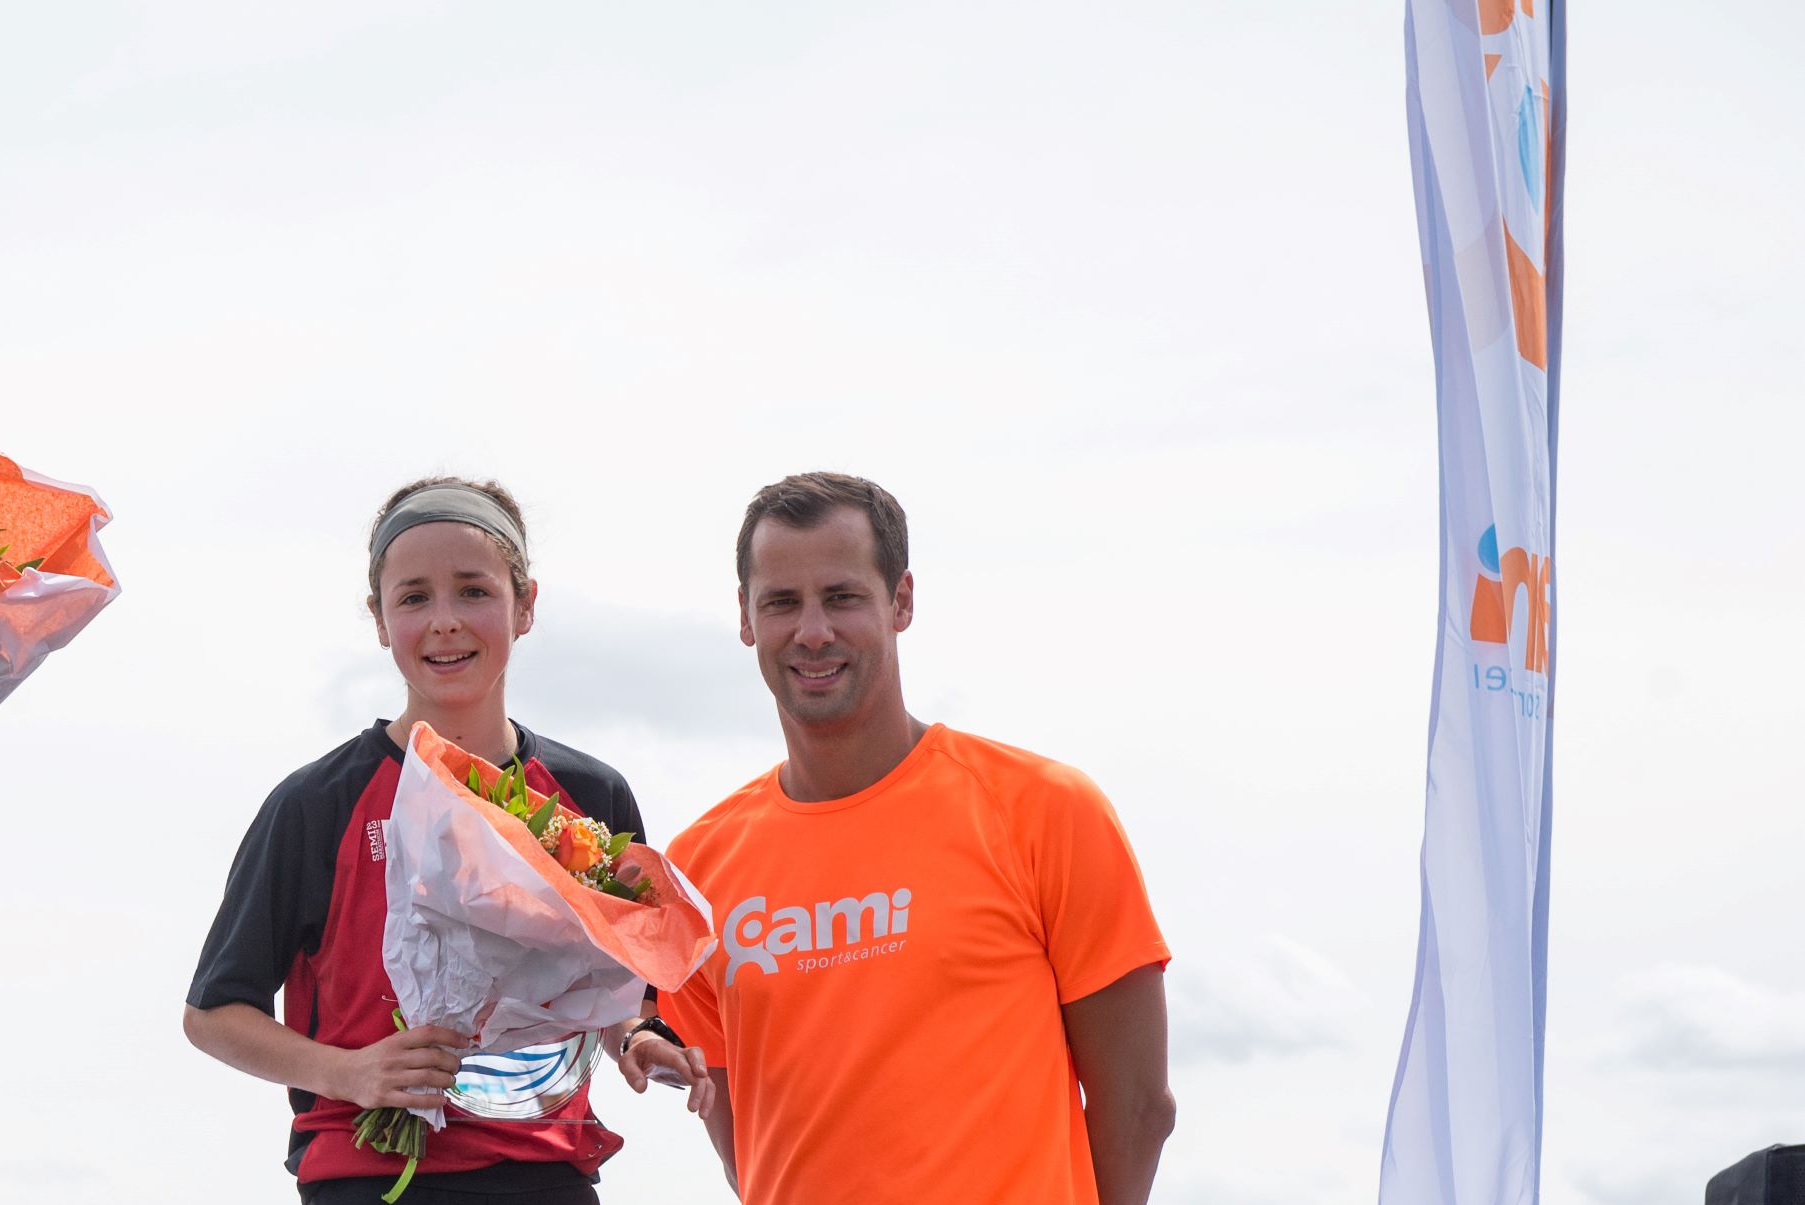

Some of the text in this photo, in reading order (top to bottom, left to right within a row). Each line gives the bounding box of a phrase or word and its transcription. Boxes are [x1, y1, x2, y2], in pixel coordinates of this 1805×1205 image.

[367, 829, 380, 862] SEMI
[723, 888, 912, 957] Cami
[796, 938, 907, 974] sport&cancer
